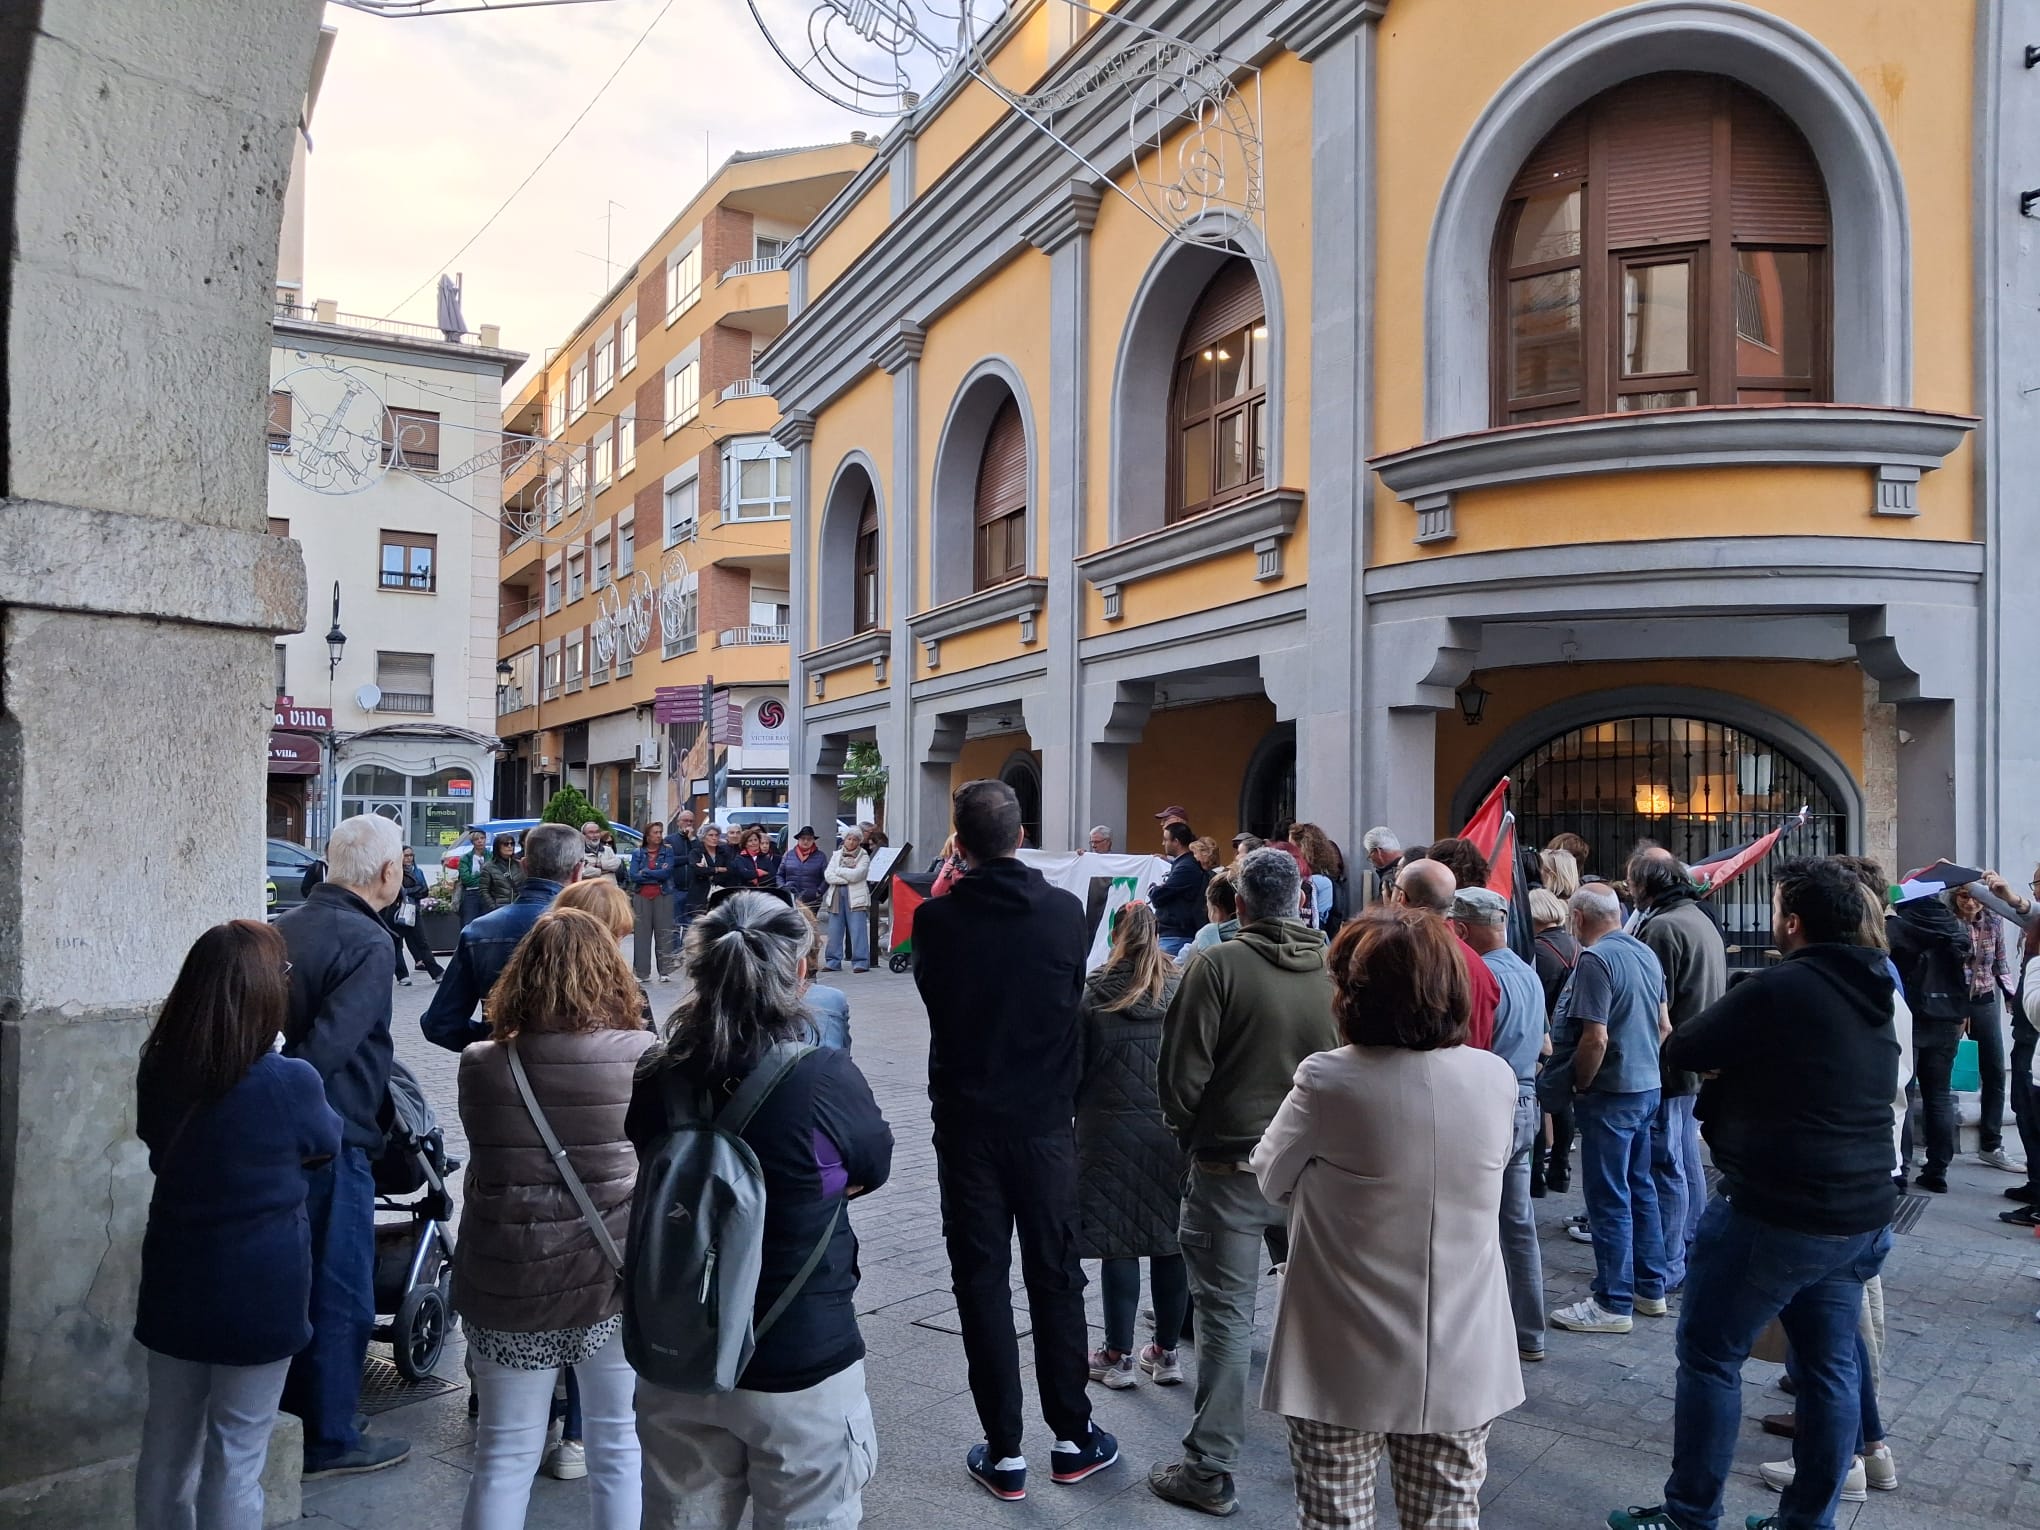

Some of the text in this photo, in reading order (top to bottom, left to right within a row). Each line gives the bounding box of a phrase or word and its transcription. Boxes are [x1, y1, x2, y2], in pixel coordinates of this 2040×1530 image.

[275, 710, 327, 727] a Villa
[275, 749, 298, 758] Villa
